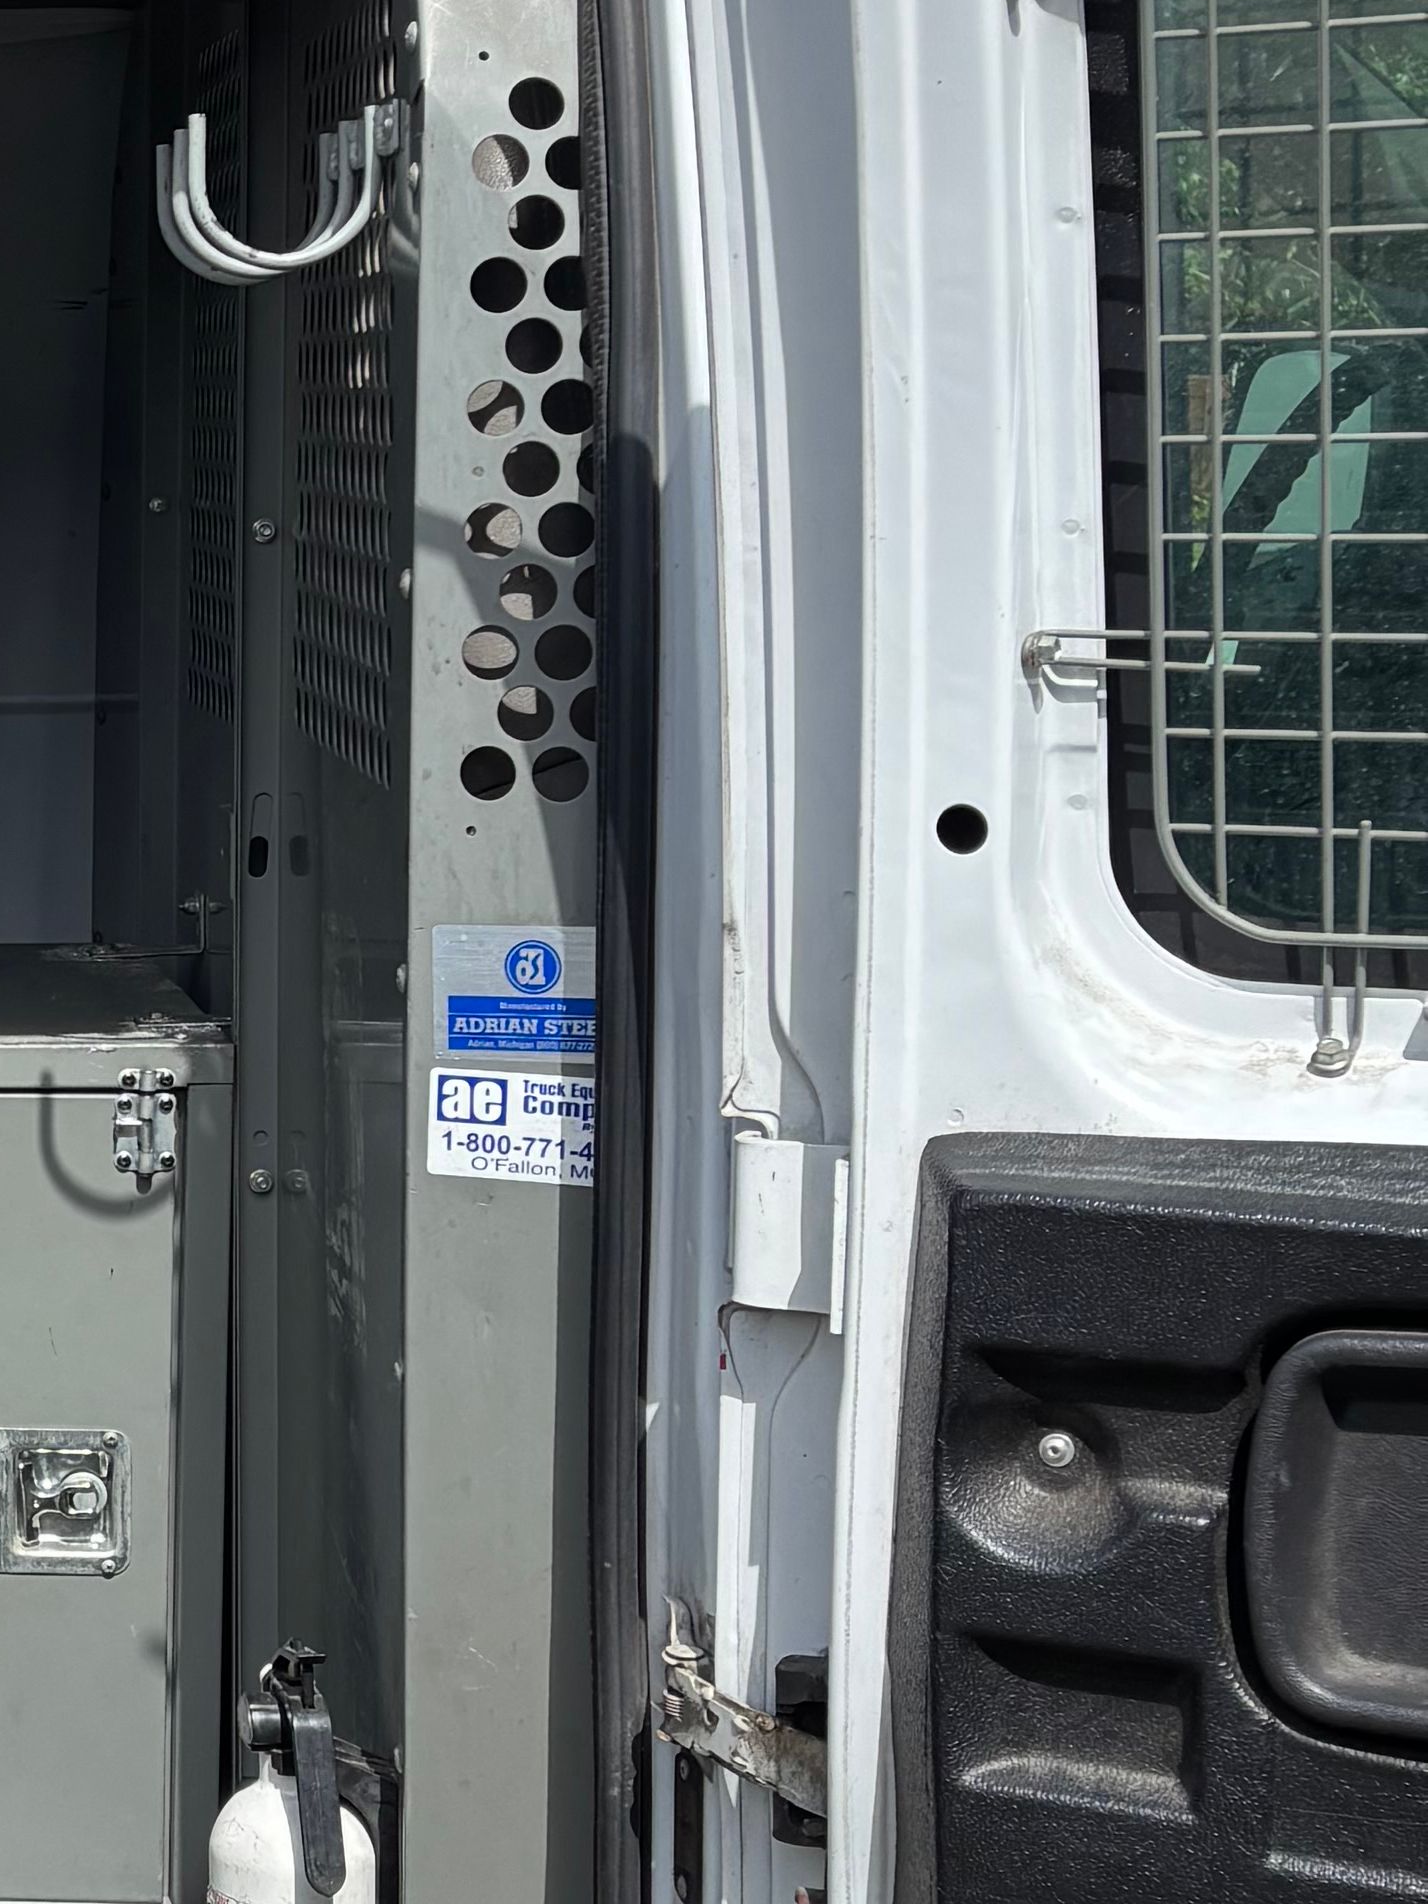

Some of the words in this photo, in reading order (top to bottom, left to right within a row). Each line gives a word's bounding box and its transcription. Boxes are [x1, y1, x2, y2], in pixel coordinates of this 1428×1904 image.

[453, 1017, 538, 1035] ADRIAN
[523, 1080, 566, 1097] Truck
[442, 1079, 503, 1122] ae
